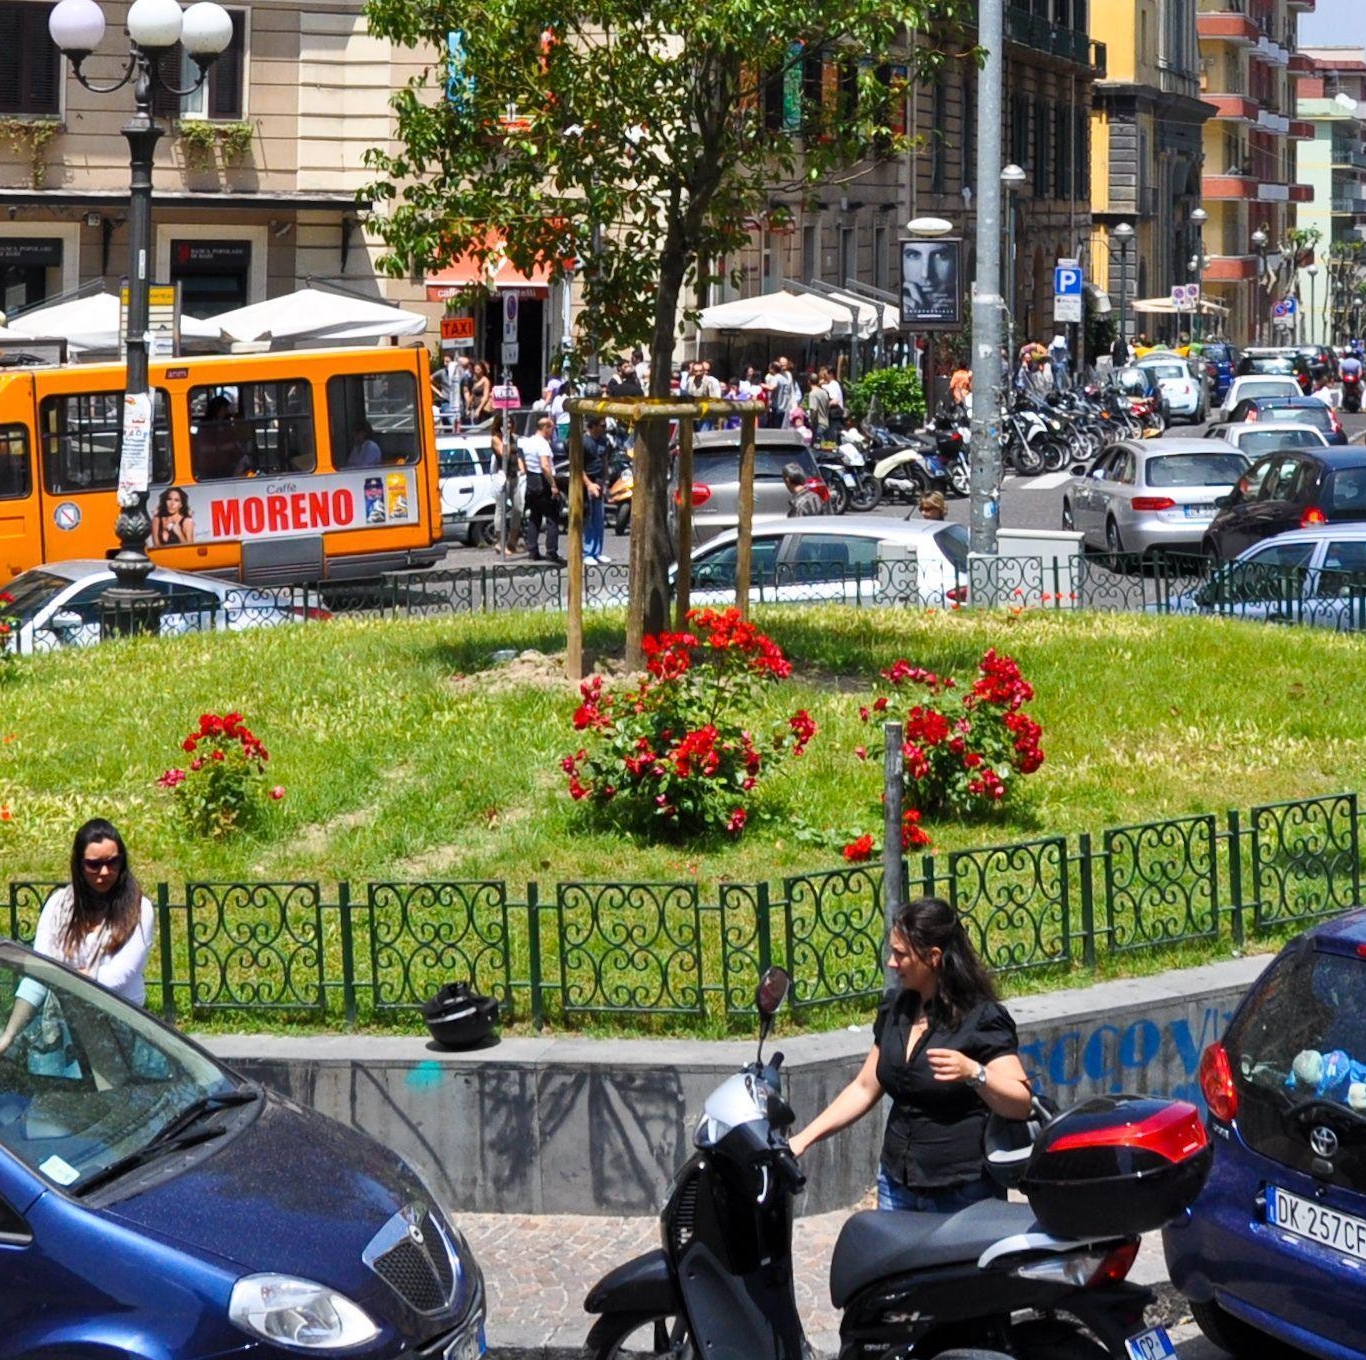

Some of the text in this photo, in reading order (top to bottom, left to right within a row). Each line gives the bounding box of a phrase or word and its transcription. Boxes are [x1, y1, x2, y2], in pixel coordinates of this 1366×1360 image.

[1060, 271, 1077, 294] P
[443, 322, 472, 336] TAXI
[211, 488, 355, 537] MORENO
[1278, 1195, 1366, 1254] DK 257CF
